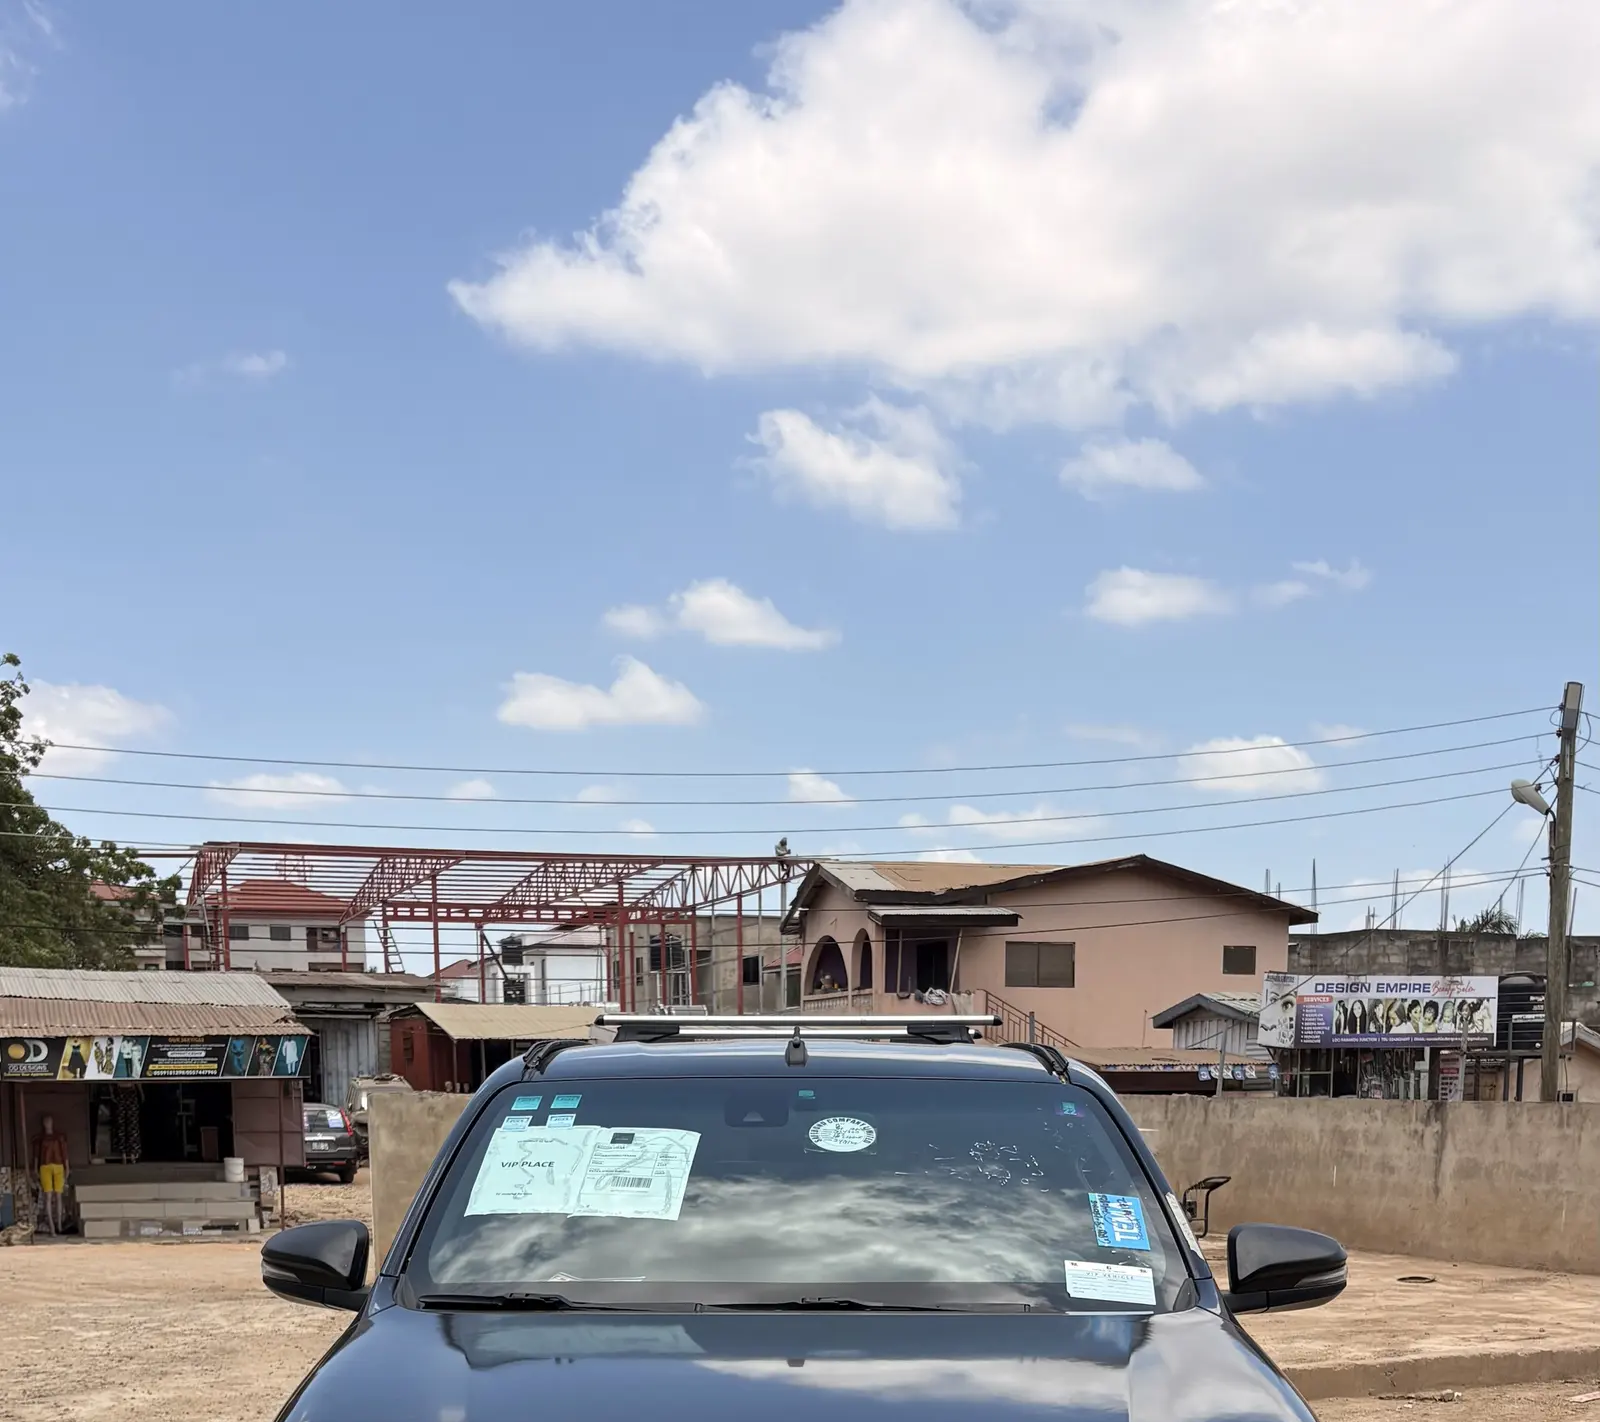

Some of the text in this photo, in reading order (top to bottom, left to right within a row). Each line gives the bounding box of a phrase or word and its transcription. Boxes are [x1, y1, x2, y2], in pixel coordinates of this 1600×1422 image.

[1314, 983, 1371, 993] DESIGN
[1376, 982, 1432, 993] EMPIRE
[827, 1117, 866, 1127] COMPANY
